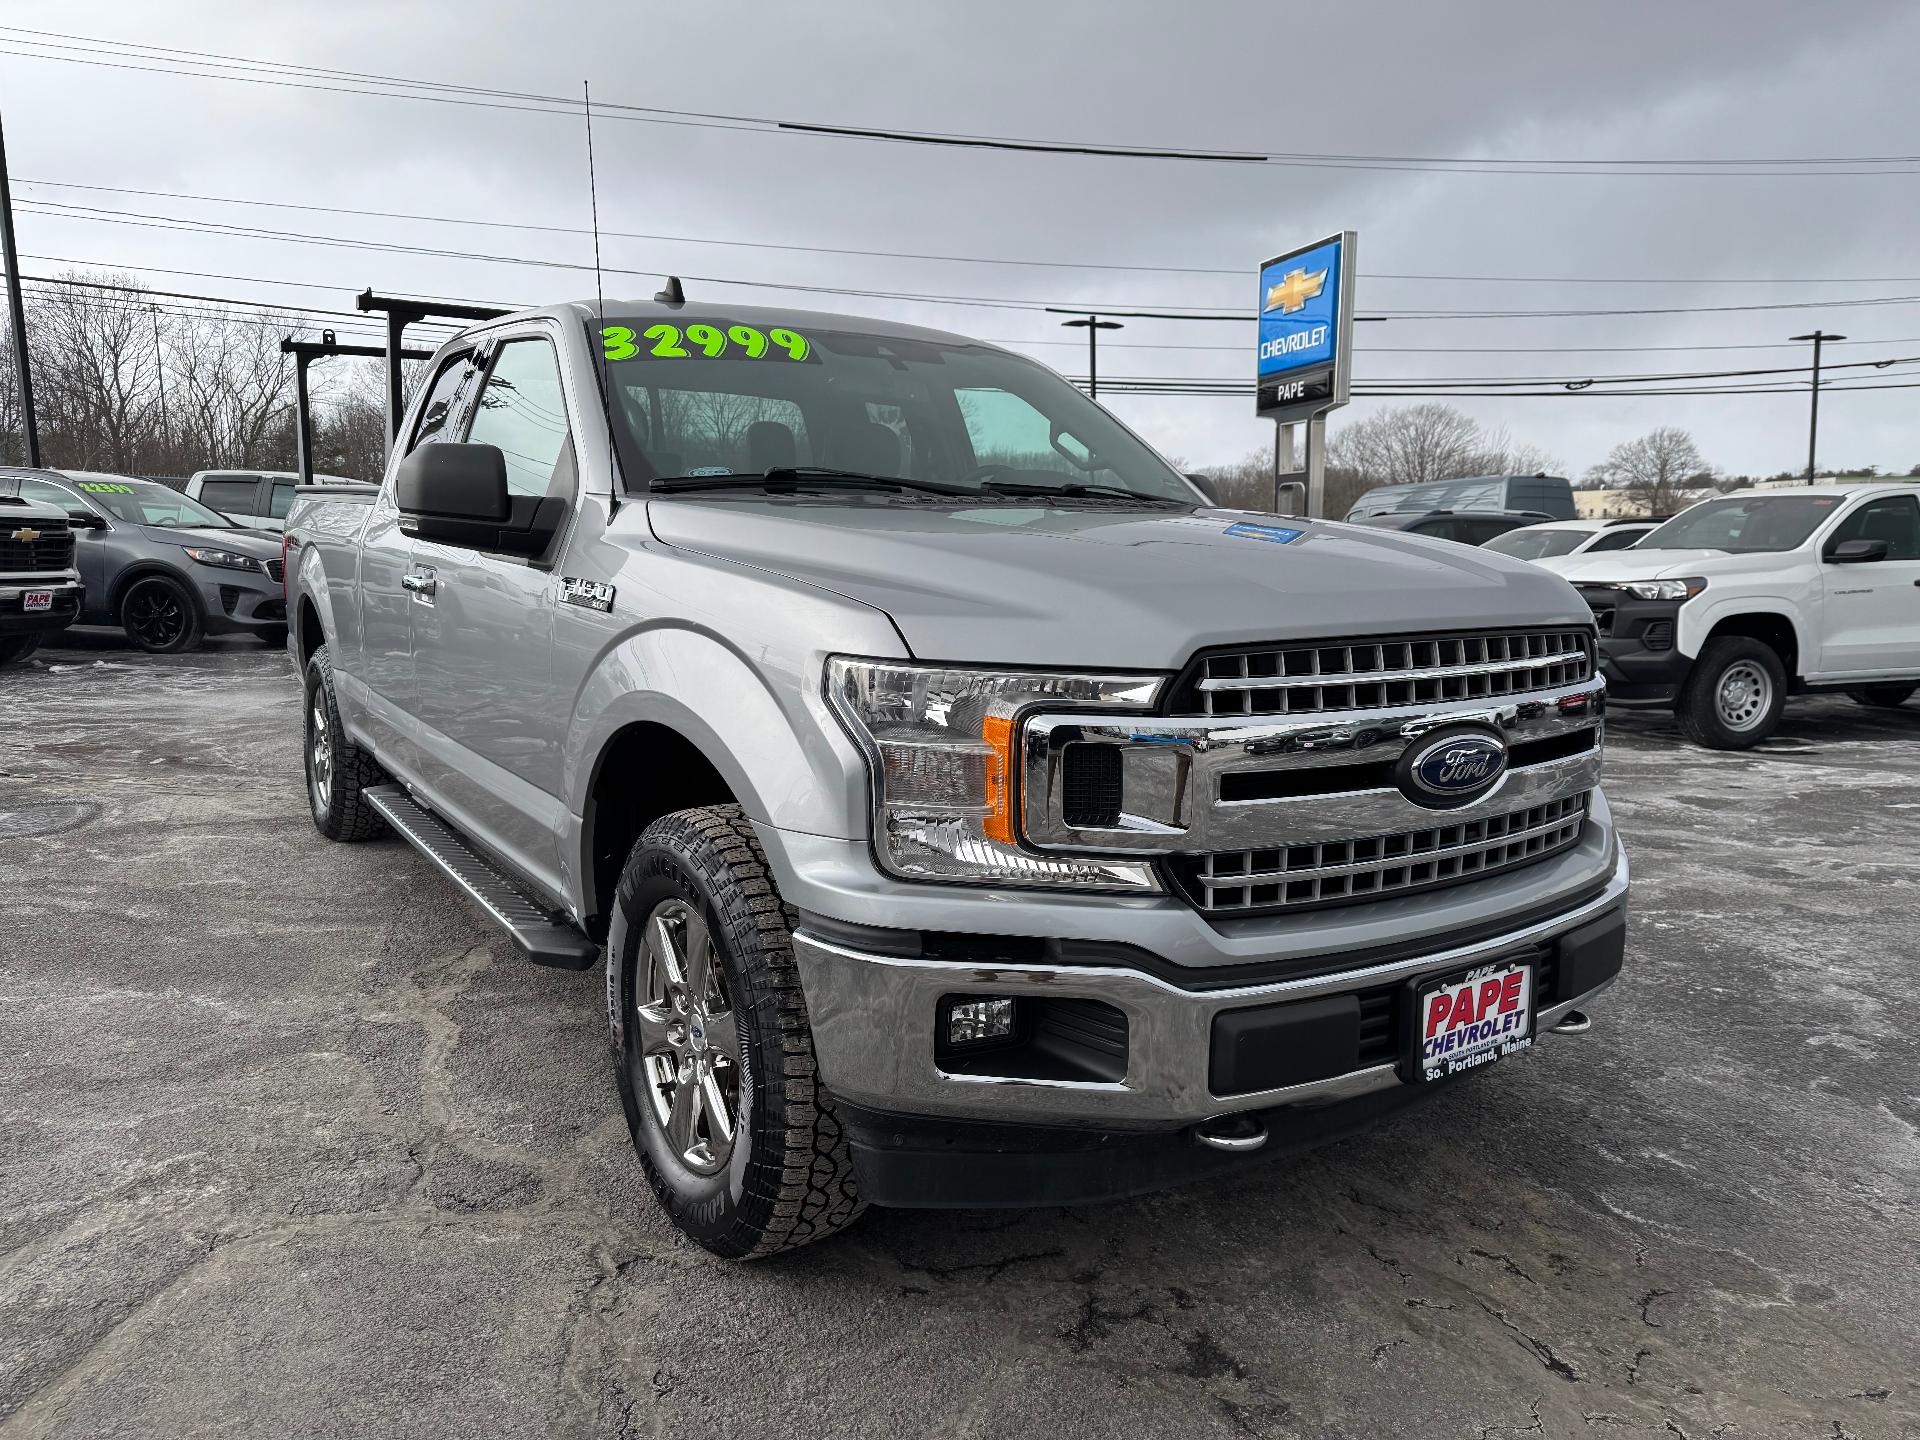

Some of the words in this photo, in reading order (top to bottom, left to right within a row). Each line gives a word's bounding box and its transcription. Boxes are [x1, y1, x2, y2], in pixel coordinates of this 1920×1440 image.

[598, 324, 811, 361] 32999
[1261, 325, 1328, 360] CHEVROLET
[1278, 381, 1305, 402] PAPE
[27, 594, 51, 602] PAPE
[1439, 748, 1491, 783] Ford
[1465, 964, 1497, 983] PAPE
[1425, 970, 1524, 1039] PAPE
[1422, 1008, 1526, 1060] CHEVROLET
[1425, 1067, 1444, 1082] So.
[1448, 1048, 1498, 1075] Portland,
[1501, 1037, 1532, 1056] Maine
